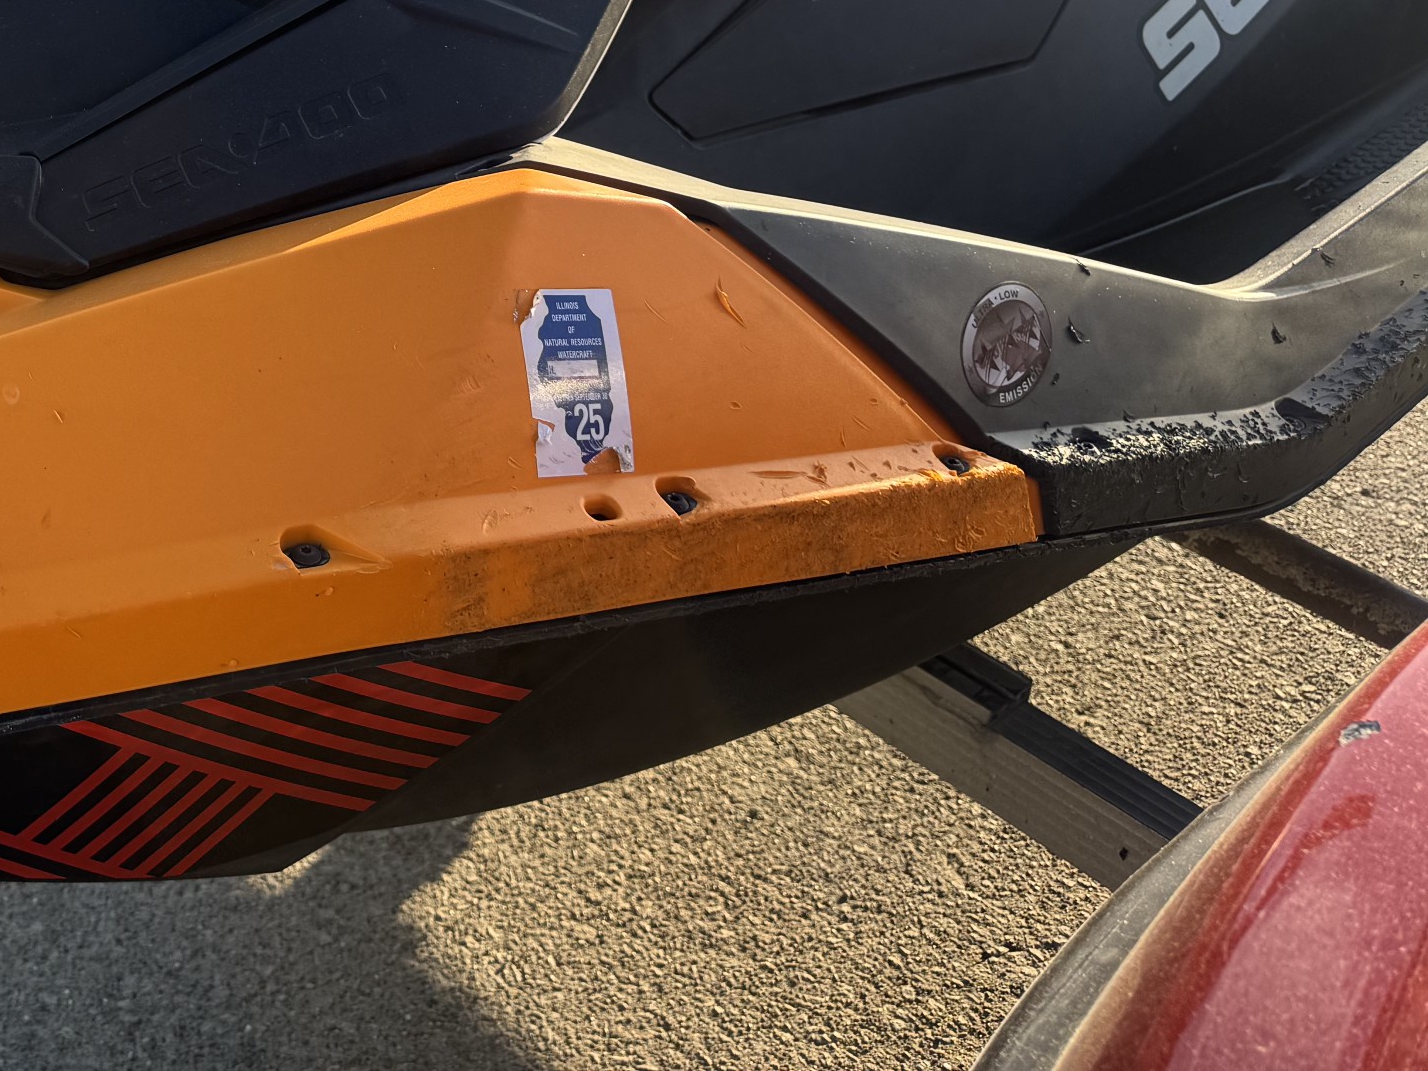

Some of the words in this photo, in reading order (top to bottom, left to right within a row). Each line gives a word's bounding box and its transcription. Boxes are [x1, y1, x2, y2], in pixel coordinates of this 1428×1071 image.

[999, 290, 1019, 300] LOW
[556, 301, 579, 310] ILLINOIS
[552, 314, 586, 322] DEPARTMENT
[544, 339, 569, 347] NATURAL
[571, 338, 602, 346] RESOURCES
[558, 350, 593, 359] WATERCRAFT
[999, 364, 1043, 403] EMISSION
[574, 403, 605, 441] 25
